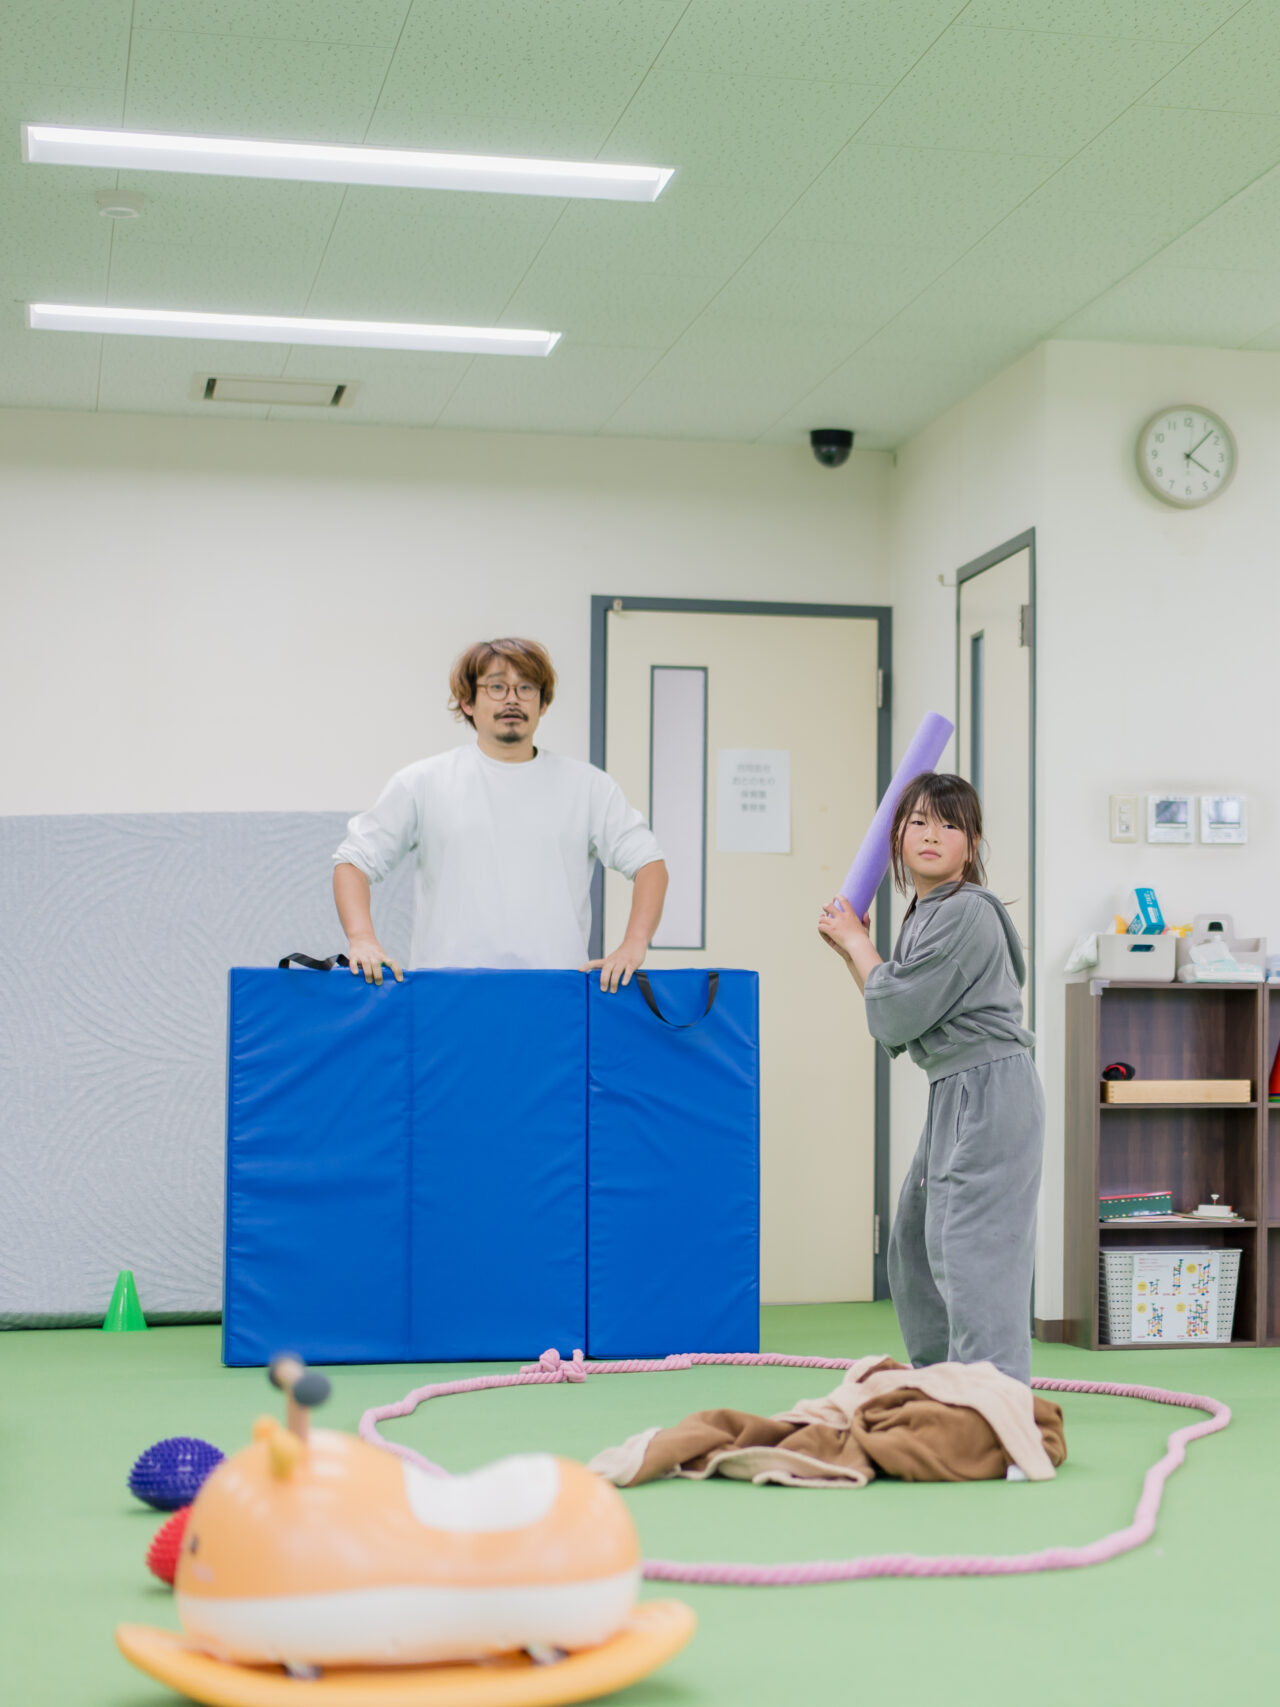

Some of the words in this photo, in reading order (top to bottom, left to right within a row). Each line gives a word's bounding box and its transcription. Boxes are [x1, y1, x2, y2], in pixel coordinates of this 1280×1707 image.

[1168, 420, 1176, 431] 11
[1184, 417, 1193, 427] 12
[1155, 433, 1164, 443] 10
